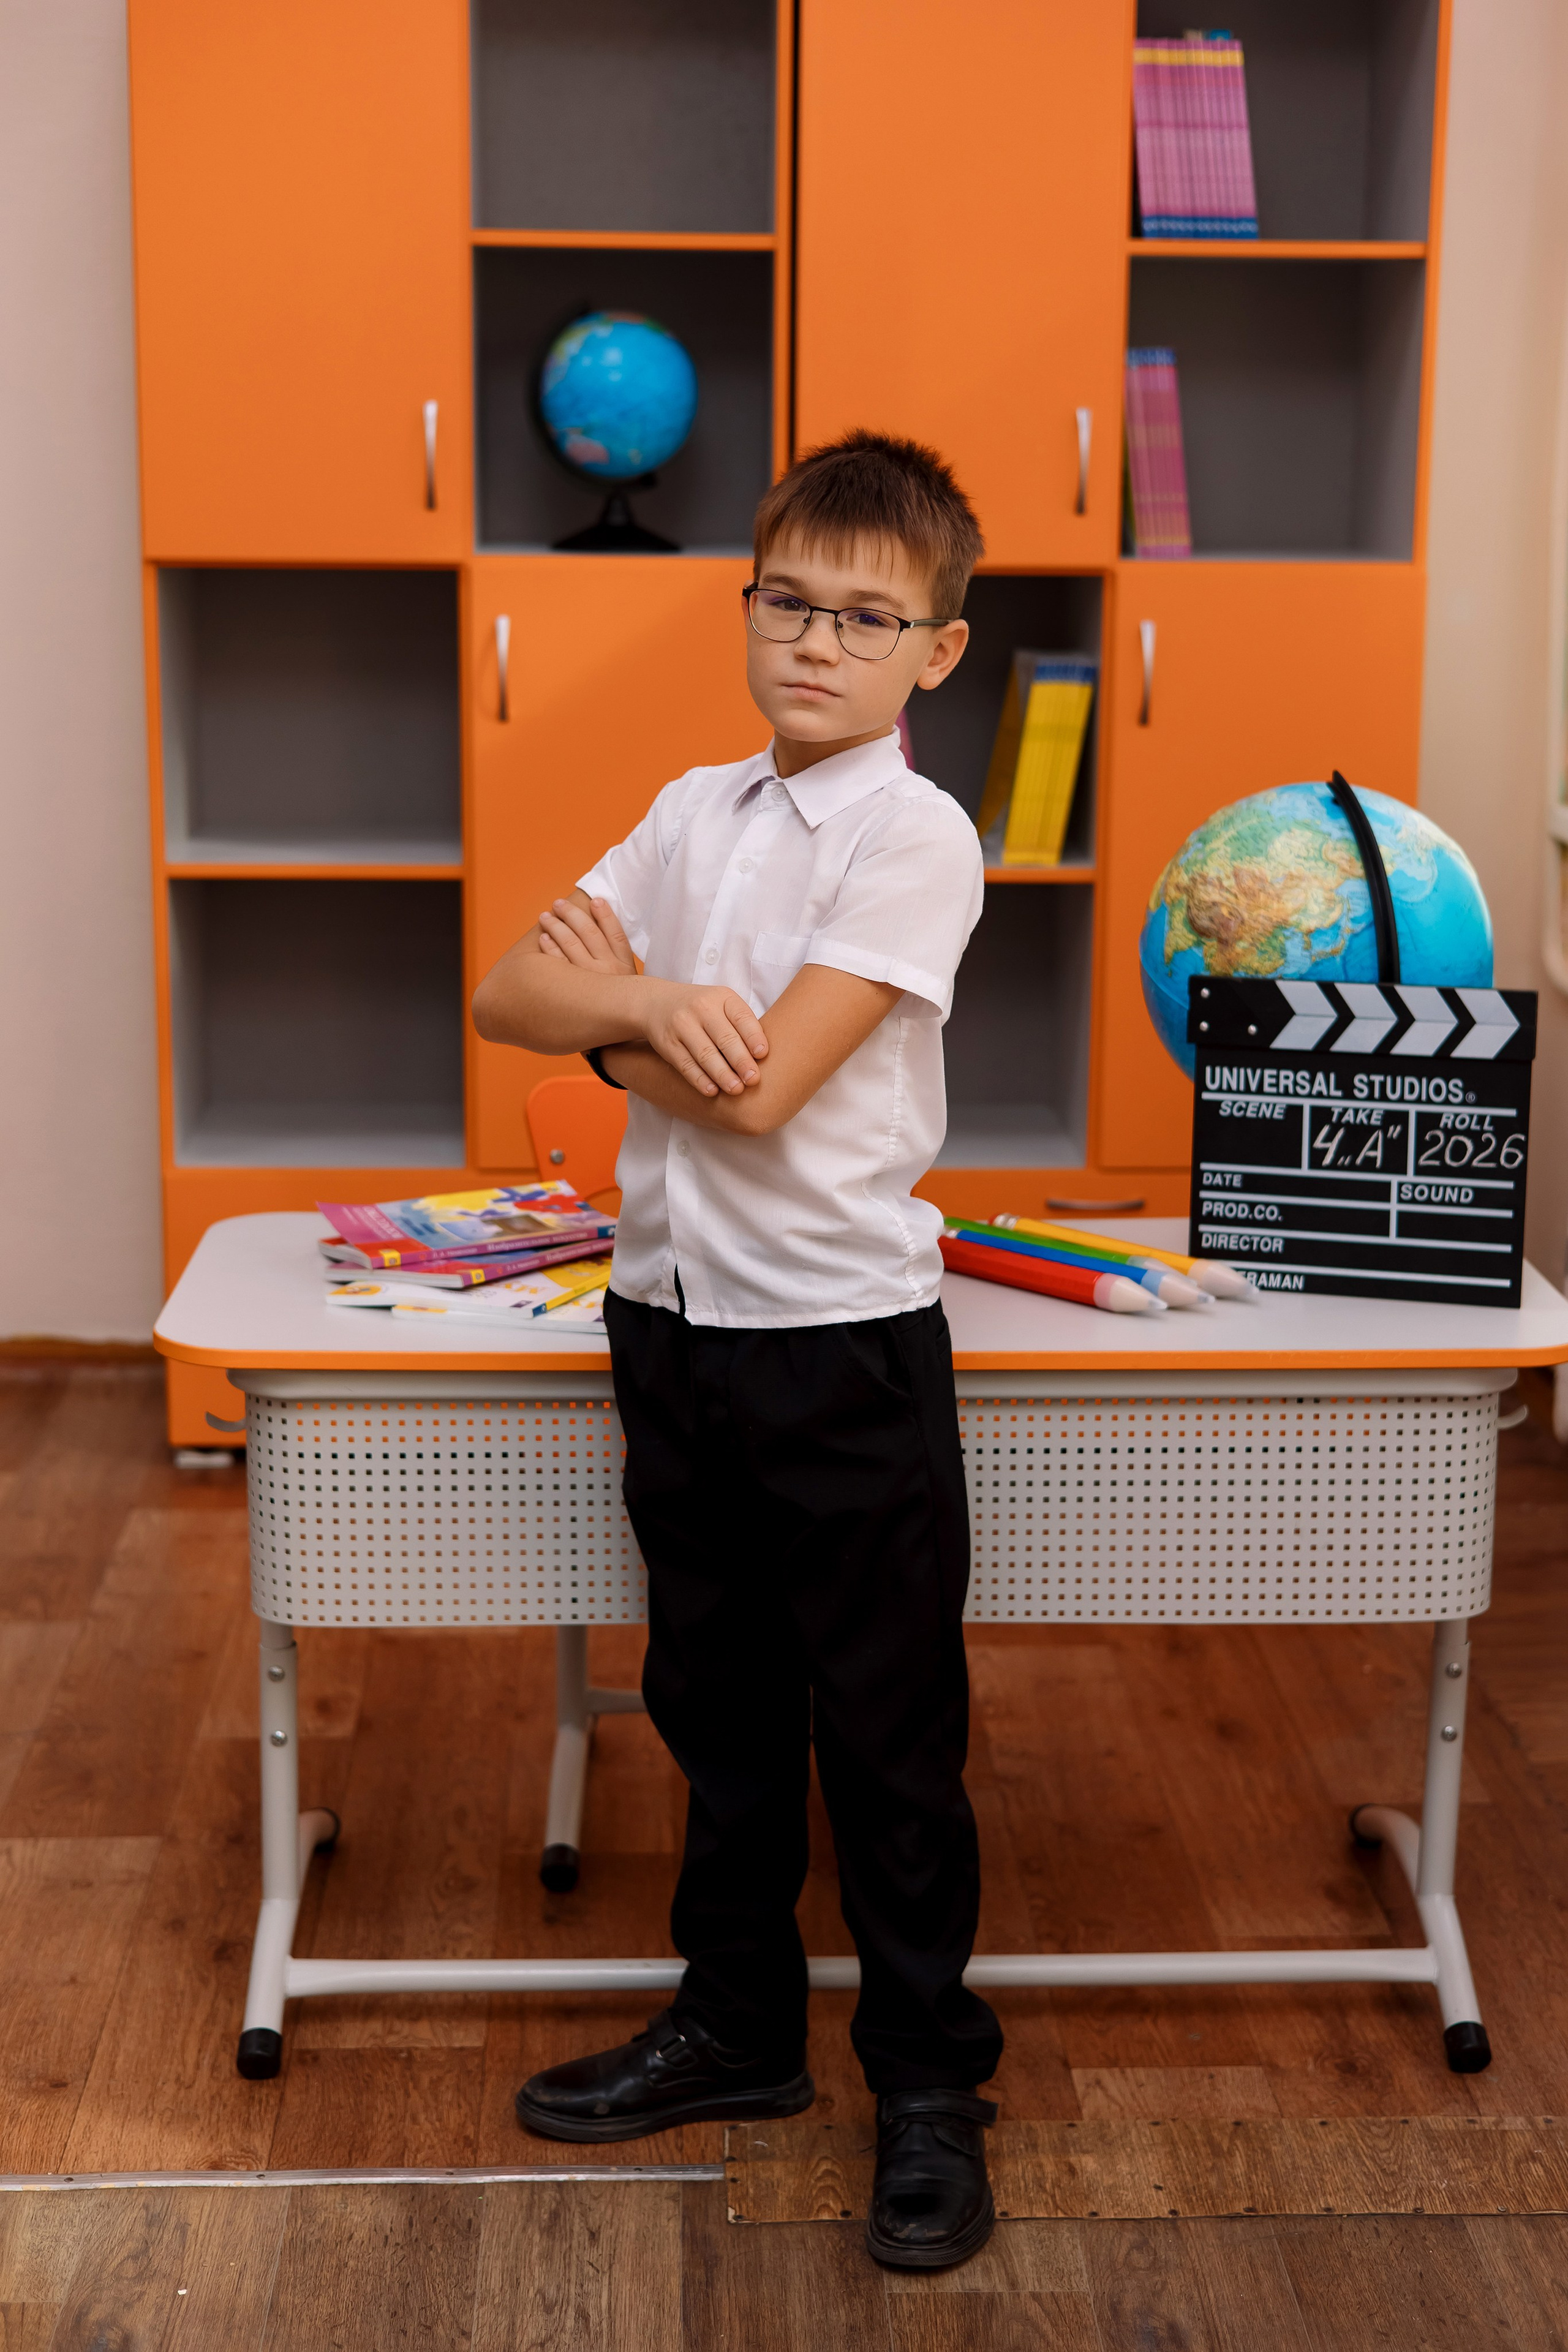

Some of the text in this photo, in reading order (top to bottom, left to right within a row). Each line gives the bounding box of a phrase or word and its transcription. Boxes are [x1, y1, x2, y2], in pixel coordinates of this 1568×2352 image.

[1205, 1065, 1344, 1098] UNIVERSAL
[1219, 1100, 1287, 1120] SCENE
[1330, 1107, 1385, 1126] TAKE
[1439, 1112, 1494, 1131] ROLL
[1418, 1129, 1526, 1169] 2026
[1202, 1172, 1243, 1188] DATE
[1400, 1183, 1475, 1204] SOUND
[1201, 1200, 1284, 1222] PROD.CO.
[1200, 1233, 1285, 1253] DIRECTOR
